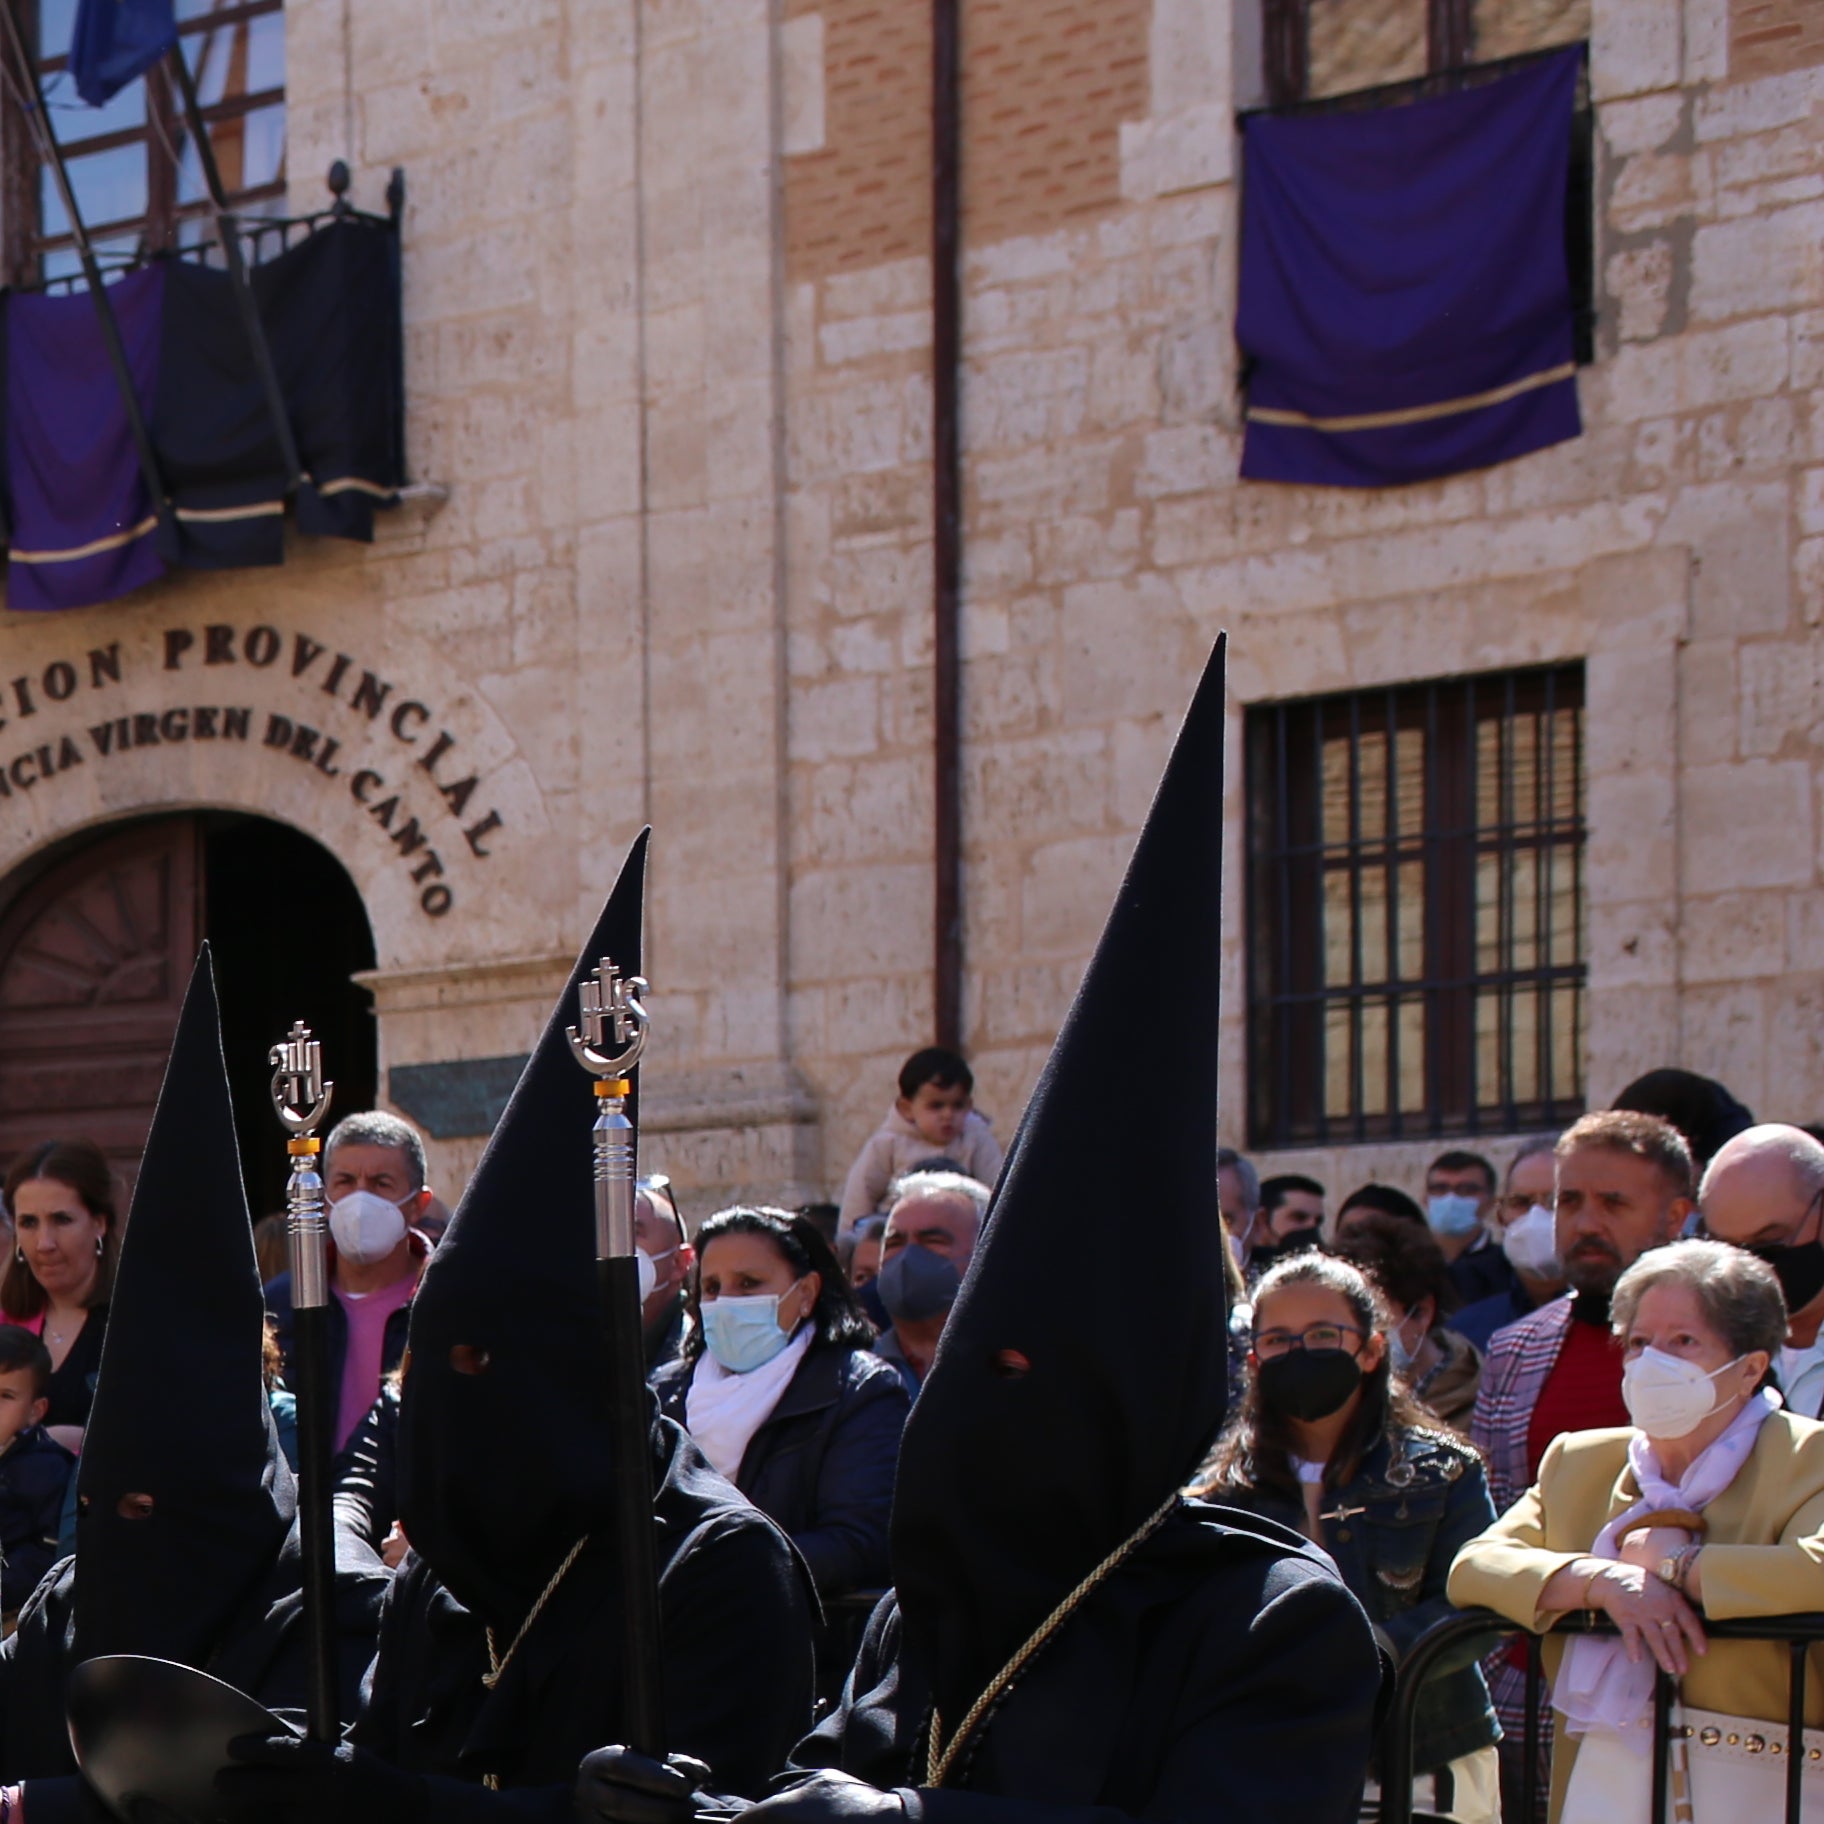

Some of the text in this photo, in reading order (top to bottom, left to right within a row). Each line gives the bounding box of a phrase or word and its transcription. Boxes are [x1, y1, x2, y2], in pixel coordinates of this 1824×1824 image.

[90, 706, 252, 757] VIRGEN
[263, 714, 343, 778] DEL
[350, 769, 453, 918] CANTO
[163, 624, 511, 860] PROVINCIAL
